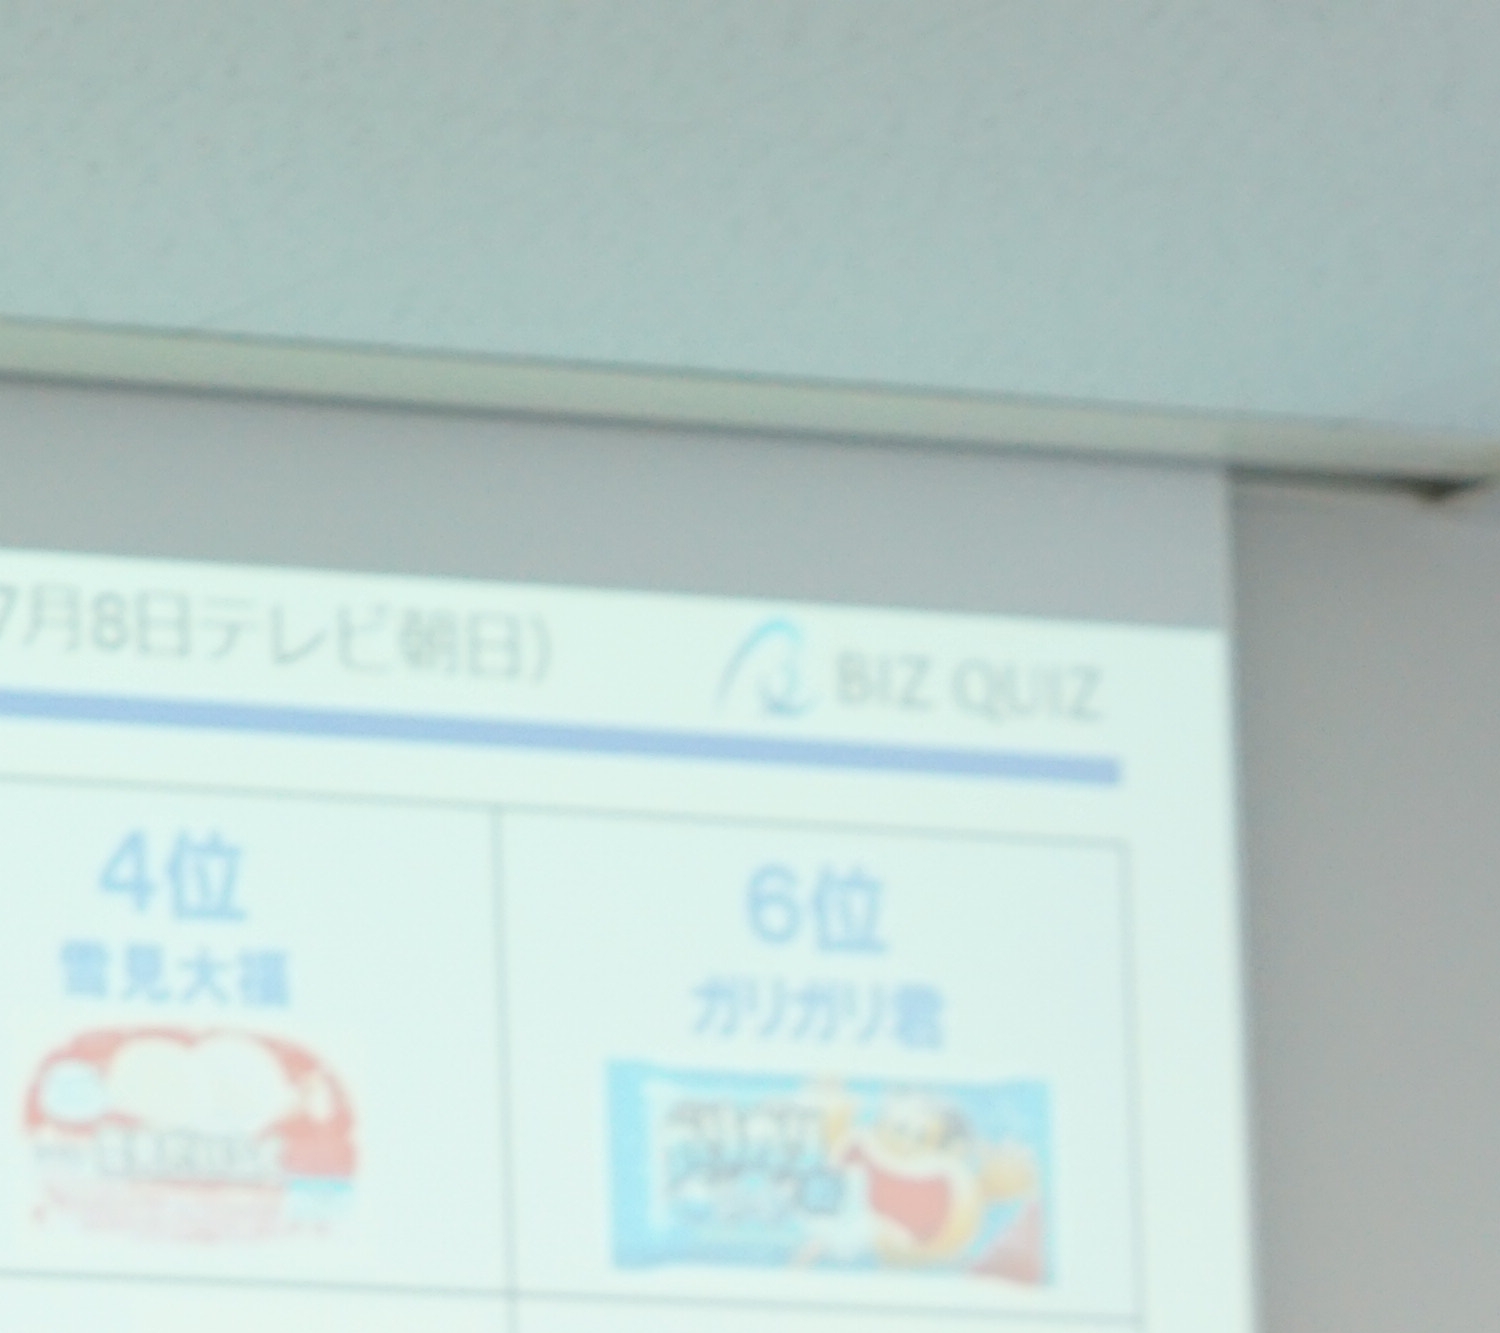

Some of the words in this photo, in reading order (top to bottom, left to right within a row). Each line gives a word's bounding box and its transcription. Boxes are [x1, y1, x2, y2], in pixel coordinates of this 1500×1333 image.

[834, 652, 933, 711] BIZ
[952, 658, 1103, 726] QUIZ
[97, 828, 248, 922] 4位
[745, 864, 888, 954] 6位
